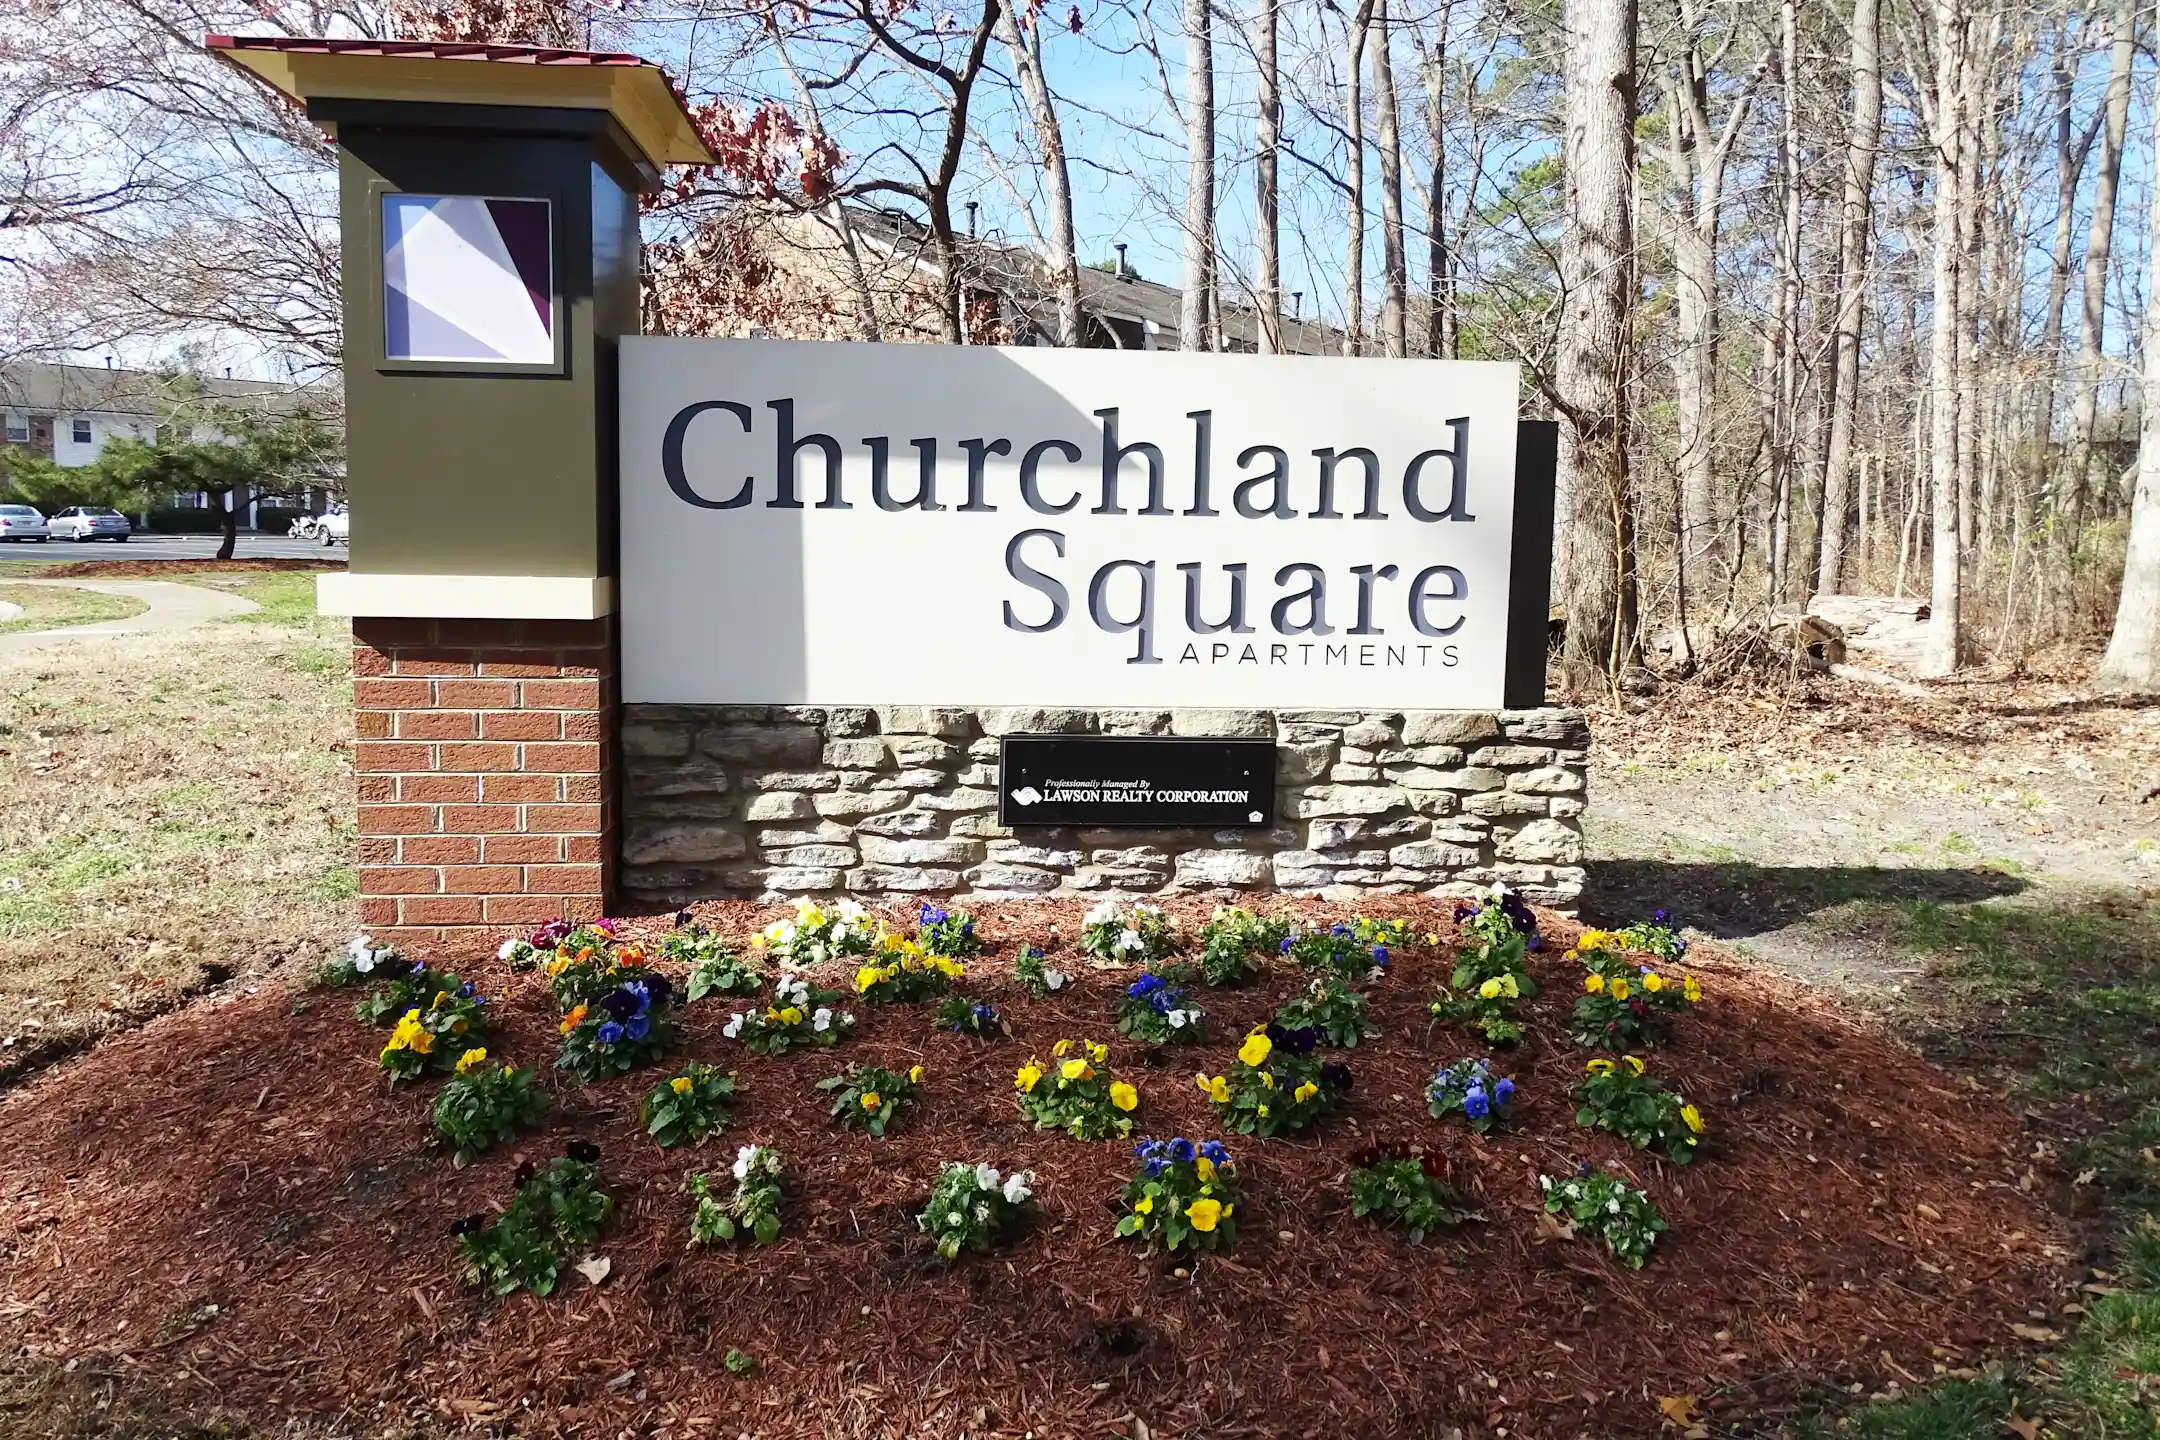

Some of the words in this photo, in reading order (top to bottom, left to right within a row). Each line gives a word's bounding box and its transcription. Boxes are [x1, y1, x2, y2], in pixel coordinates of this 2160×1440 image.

[661, 398, 1477, 523] Churchland
[1002, 528, 1469, 665] Square
[1178, 642, 1461, 668] APARTMENTS
[1043, 789, 1100, 803] LAWSON
[1101, 790, 1154, 803] REALTY
[1156, 790, 1249, 803] CORPORATION
[1044, 779, 1100, 789] Professionally
[1101, 780, 1138, 790] Managed
[1139, 781, 1151, 790] By
